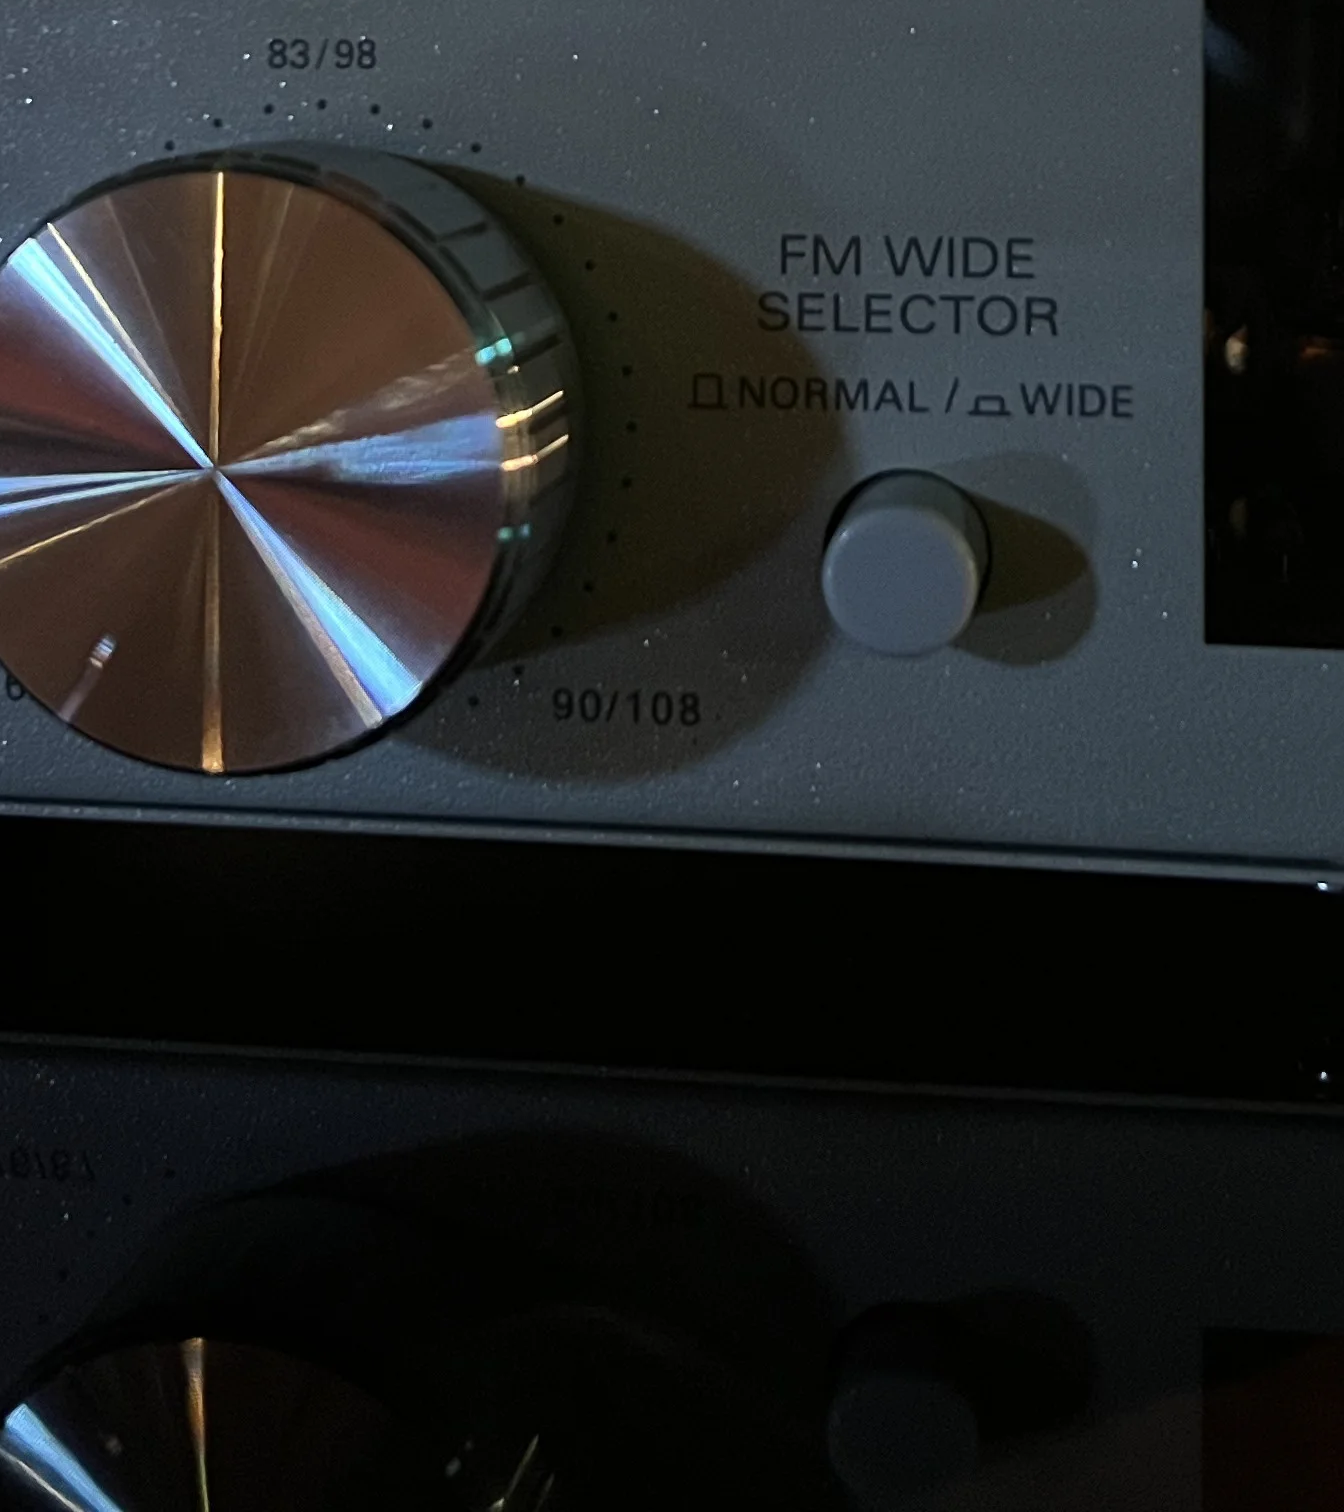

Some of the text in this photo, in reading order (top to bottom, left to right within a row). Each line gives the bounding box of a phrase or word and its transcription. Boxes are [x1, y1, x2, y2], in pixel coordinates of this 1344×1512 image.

[268, 38, 377, 70] 83/98
[780, 234, 1036, 280] FM WIDE
[758, 290, 1059, 336] SELECTOR
[738, 377, 929, 413] NORMAL
[1021, 383, 1133, 418] WIDE
[553, 688, 700, 726] 90/108
